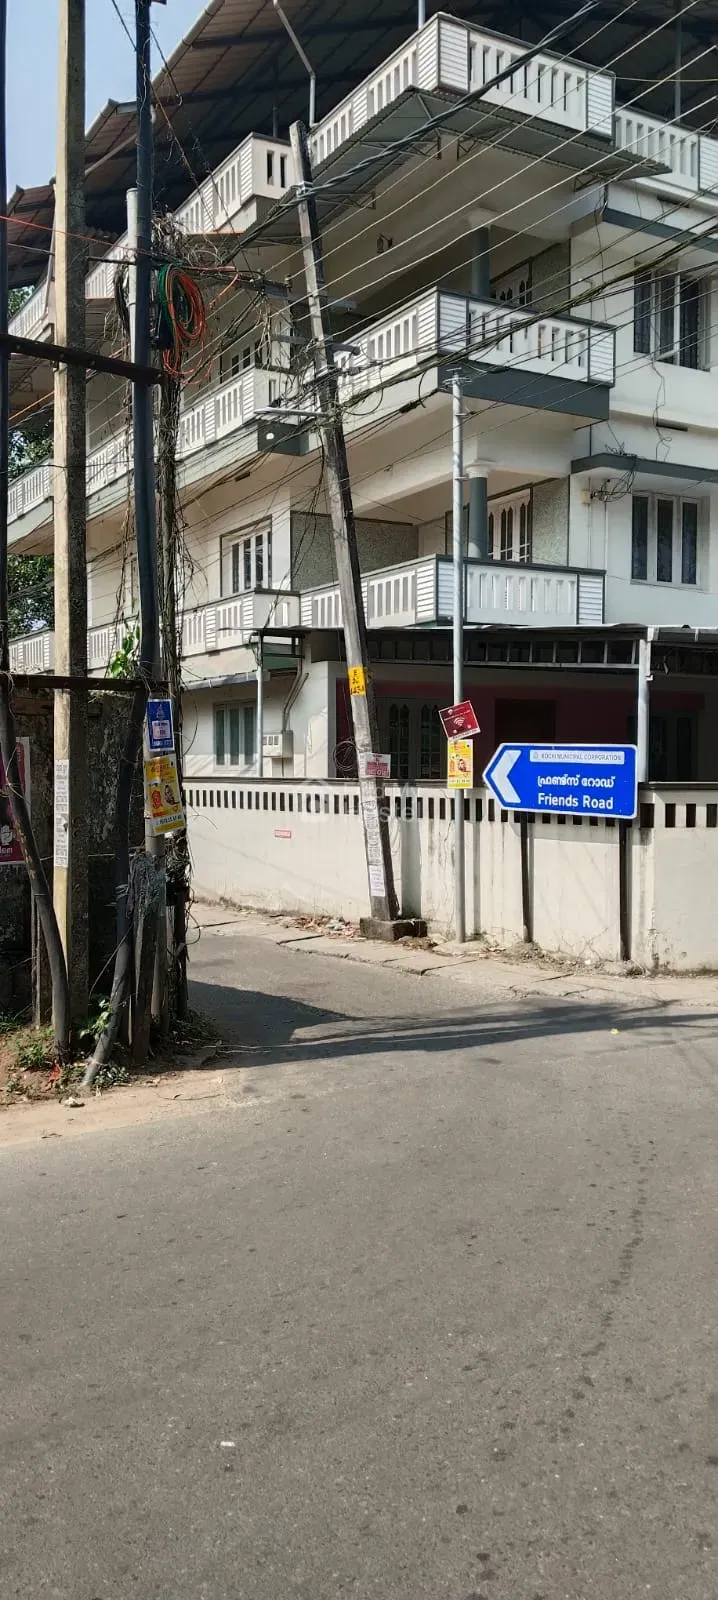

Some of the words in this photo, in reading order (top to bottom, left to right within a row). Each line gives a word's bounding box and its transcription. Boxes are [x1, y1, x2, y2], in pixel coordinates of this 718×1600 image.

[584, 753, 622, 761] CORPORATION
[581, 776, 616, 789] റോഡ്
[537, 792, 579, 807] Friends
[582, 794, 614, 810] Road
